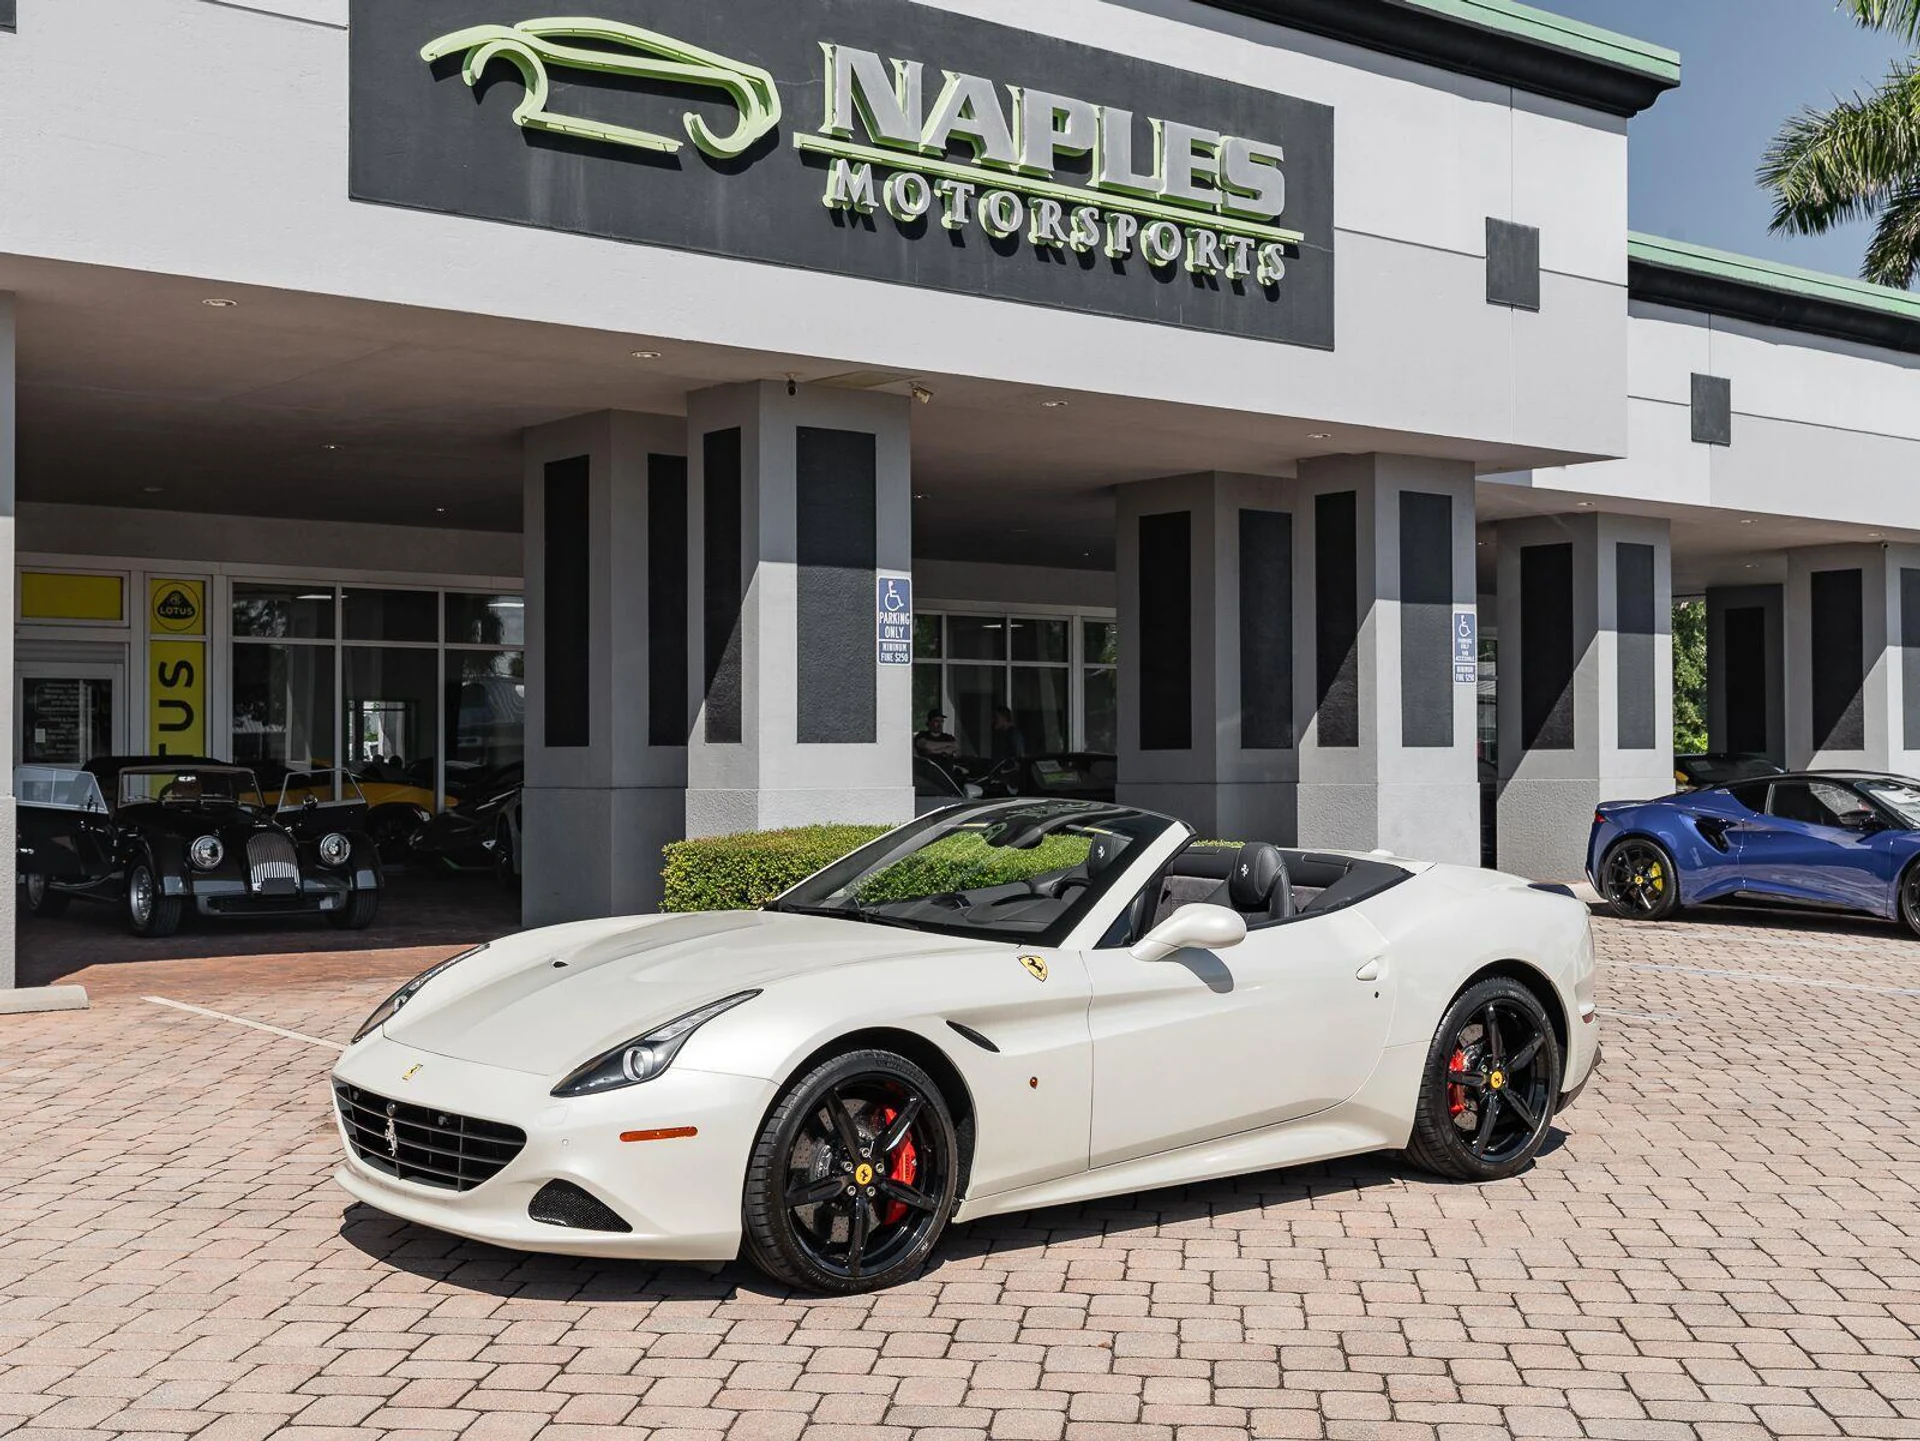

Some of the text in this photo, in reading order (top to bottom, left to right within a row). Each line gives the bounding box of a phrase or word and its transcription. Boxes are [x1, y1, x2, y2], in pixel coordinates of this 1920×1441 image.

[818, 41, 1286, 220] NAPLES
[822, 158, 1287, 286] MOTORSPORTS
[160, 606, 194, 616] LOTUS
[879, 612, 910, 625] PARKING
[884, 625, 904, 639] ONLY
[882, 642, 908, 652] MINIMUM
[880, 652, 909, 662] FINE $250
